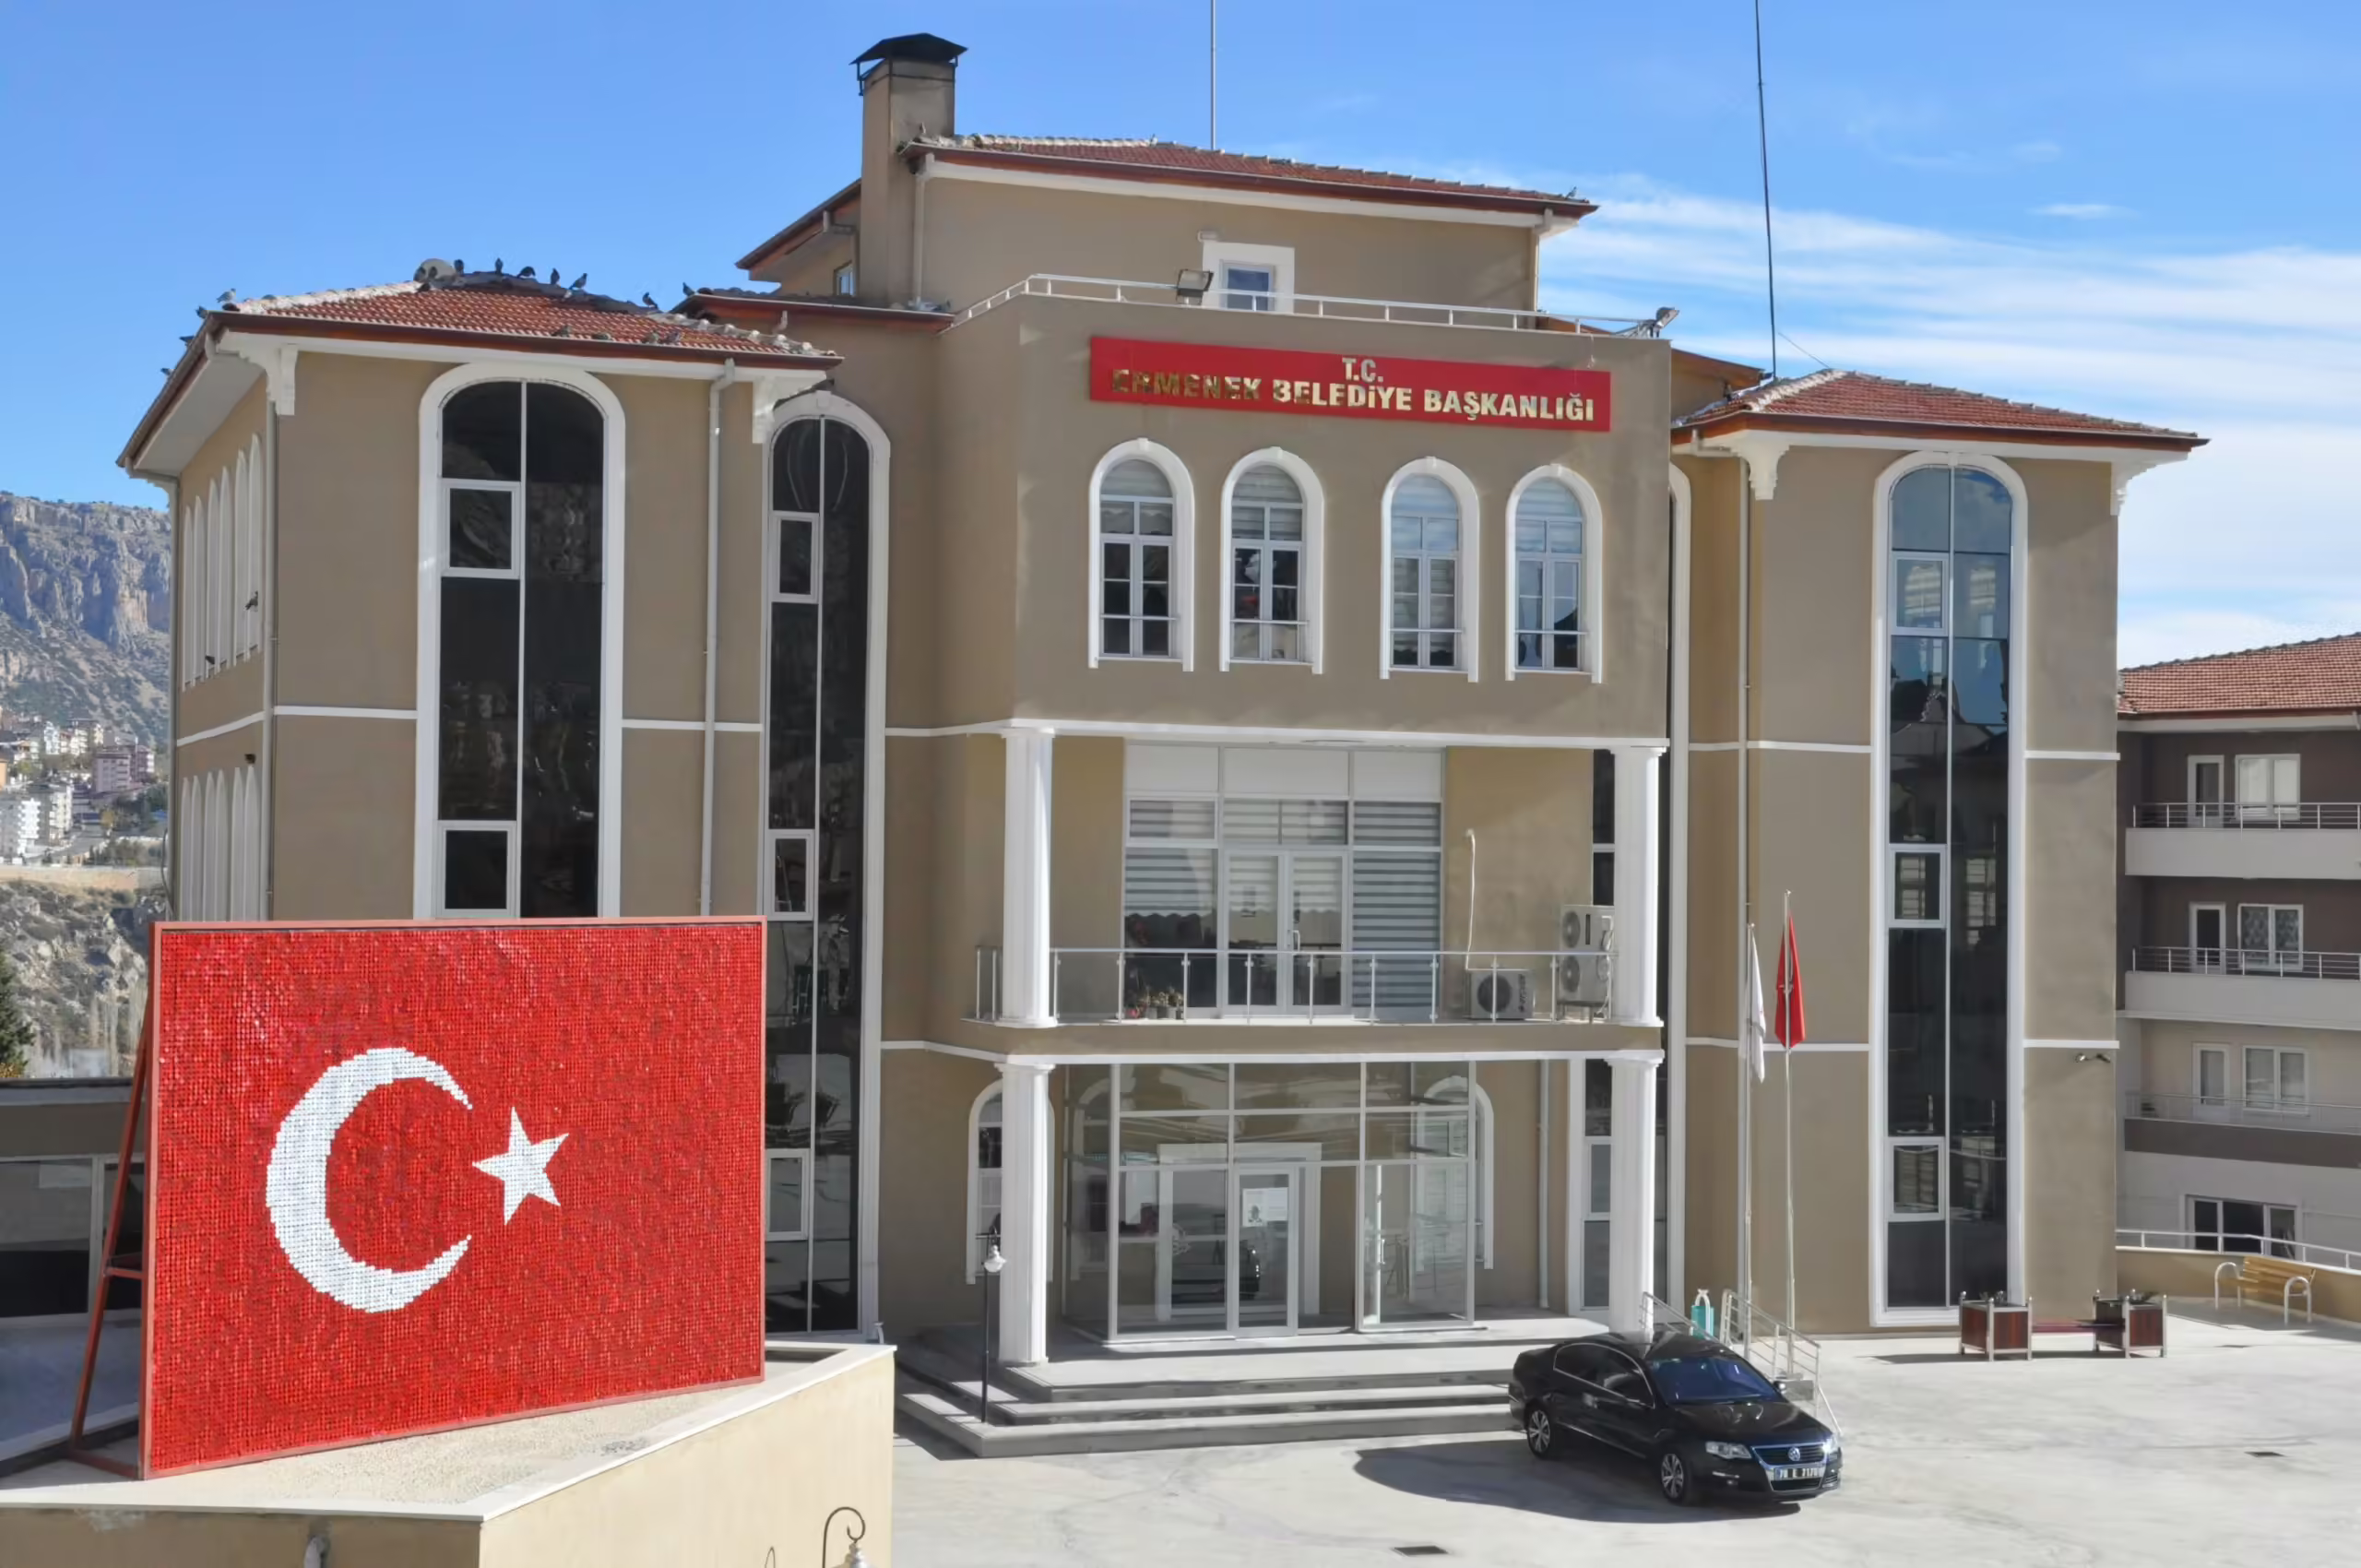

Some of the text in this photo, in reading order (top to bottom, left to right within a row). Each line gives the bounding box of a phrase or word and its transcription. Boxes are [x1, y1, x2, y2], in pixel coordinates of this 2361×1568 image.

[1342, 357, 1383, 383] T.C.
[1112, 369, 1262, 400] ERMENEK
[1424, 389, 1594, 421] BAŞKANLIĞI
